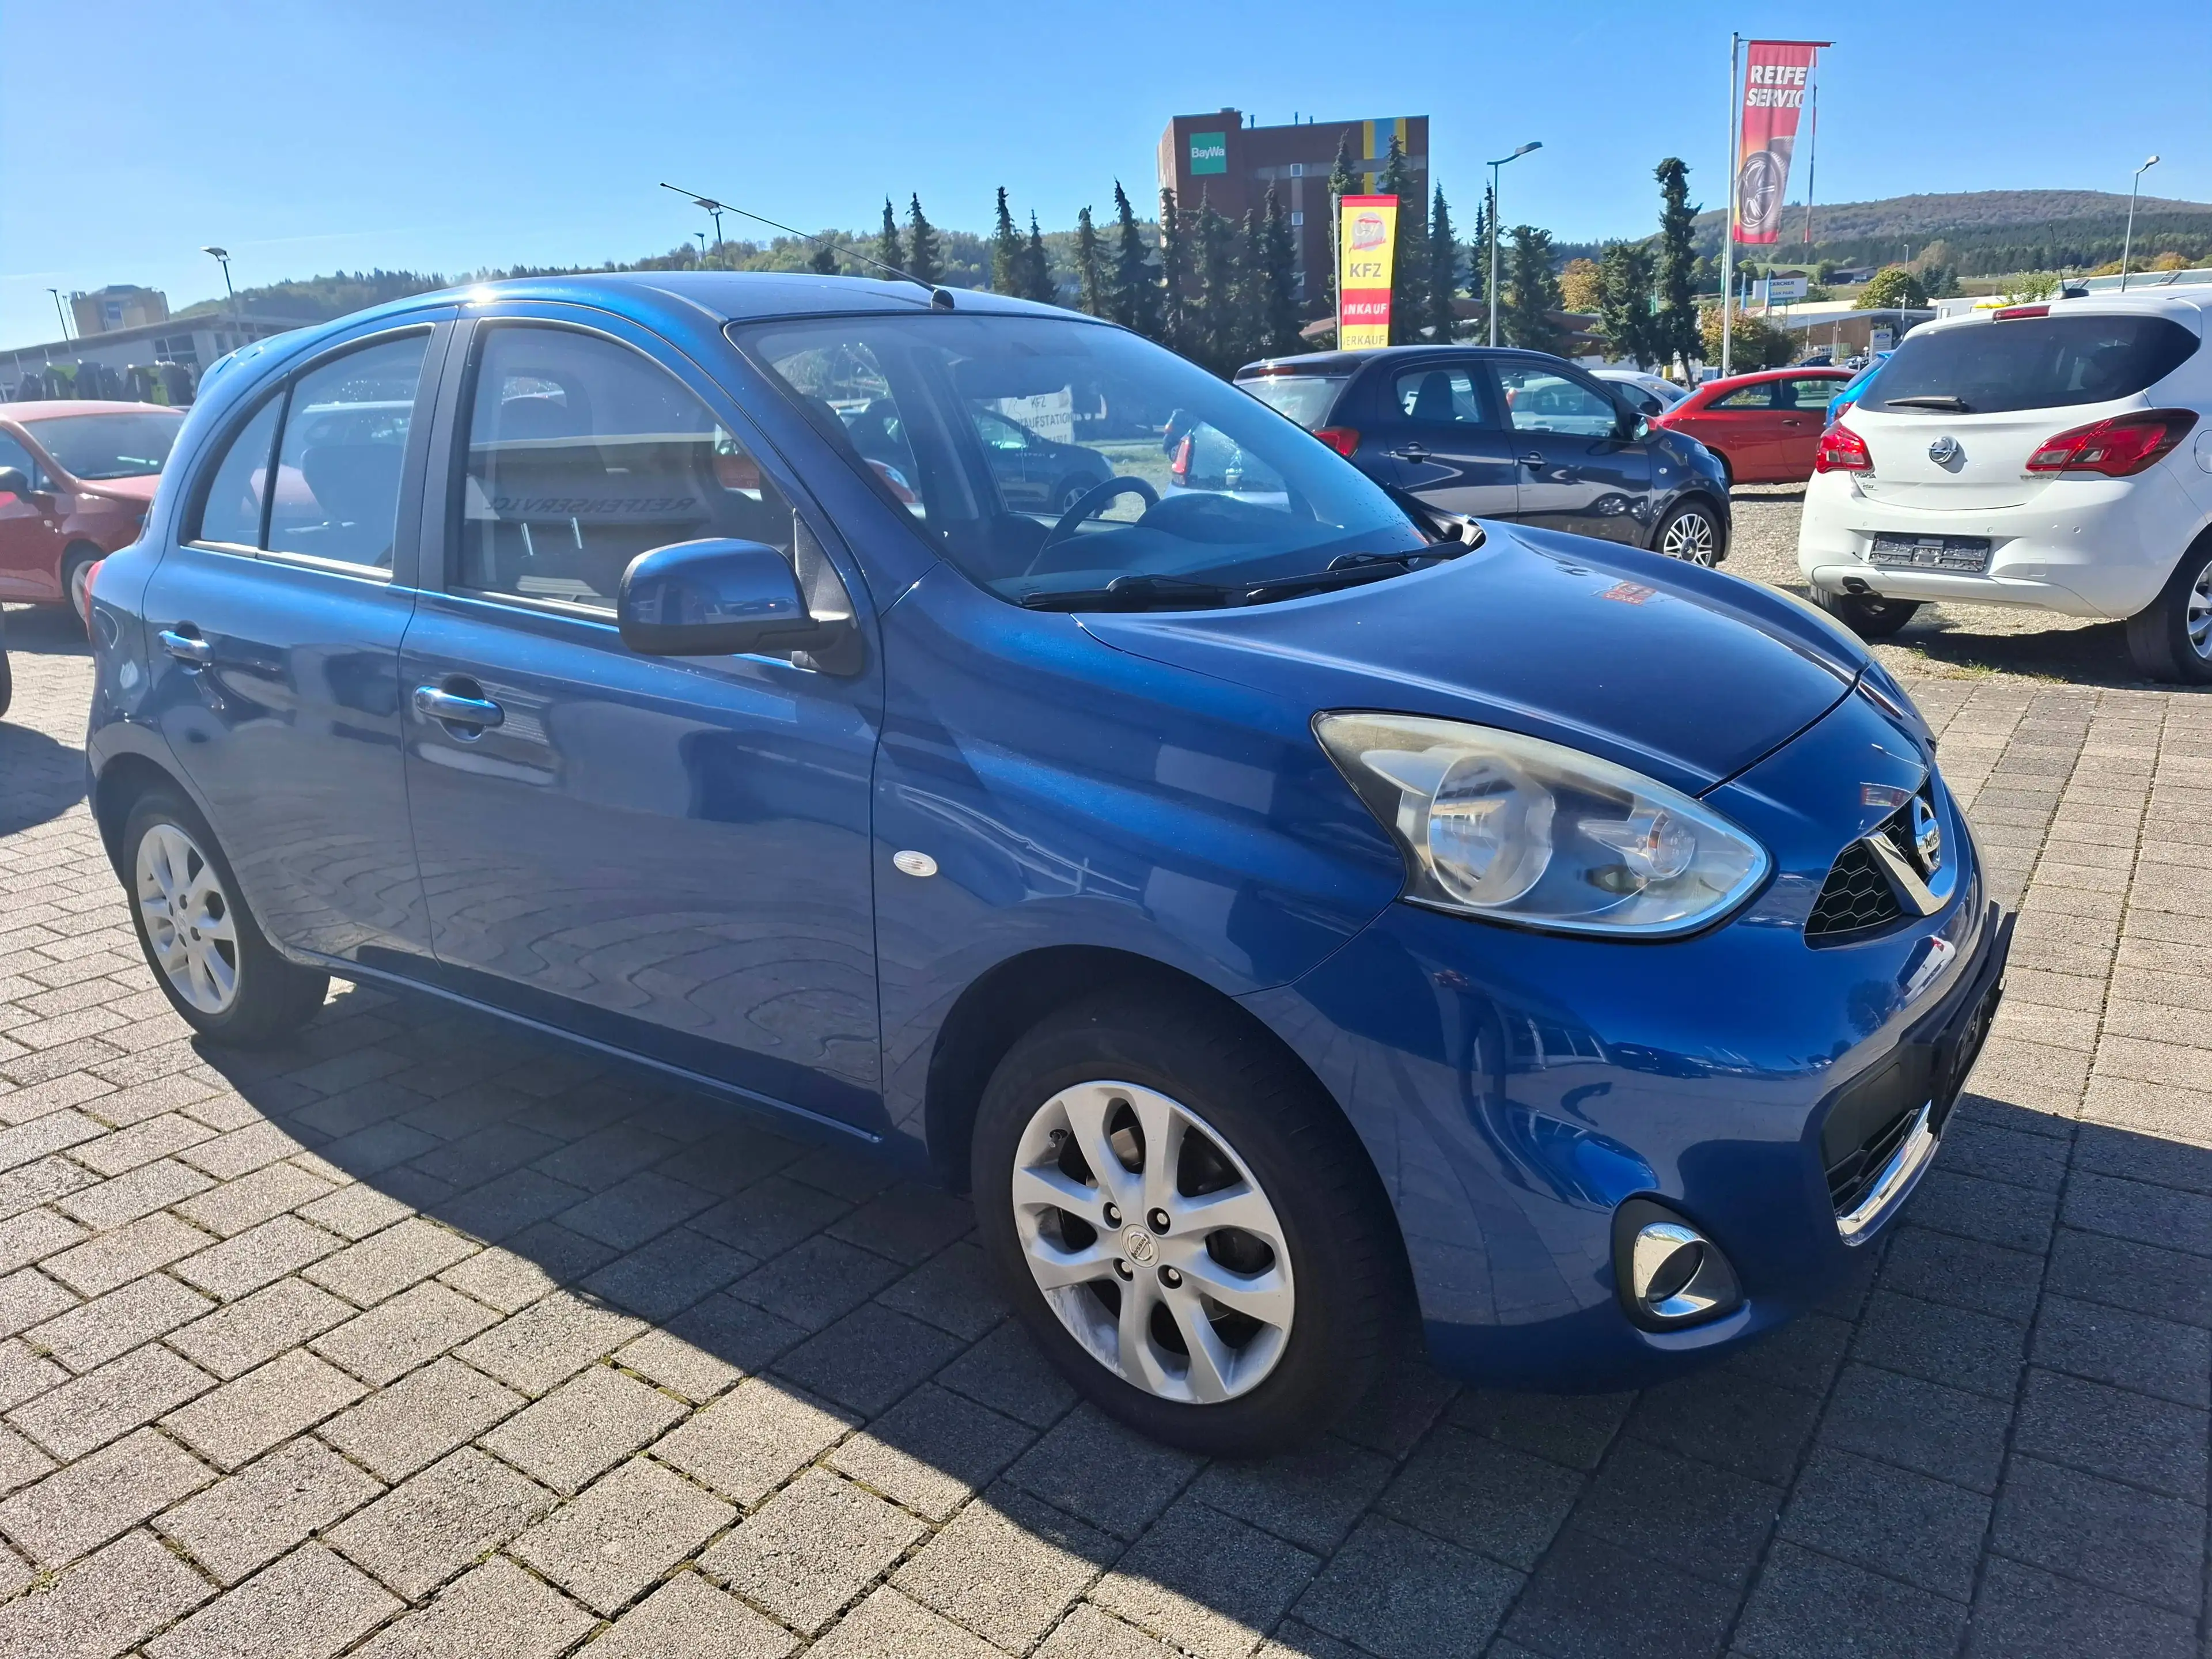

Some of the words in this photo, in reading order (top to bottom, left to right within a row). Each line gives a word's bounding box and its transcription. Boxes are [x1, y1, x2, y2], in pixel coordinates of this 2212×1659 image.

[1191, 146, 1225, 159] BayWa
[1350, 263, 1381, 278] KFZ
[1031, 396, 1046, 408] KFZ
[1134, 1237, 1146, 1255] NISSAN
